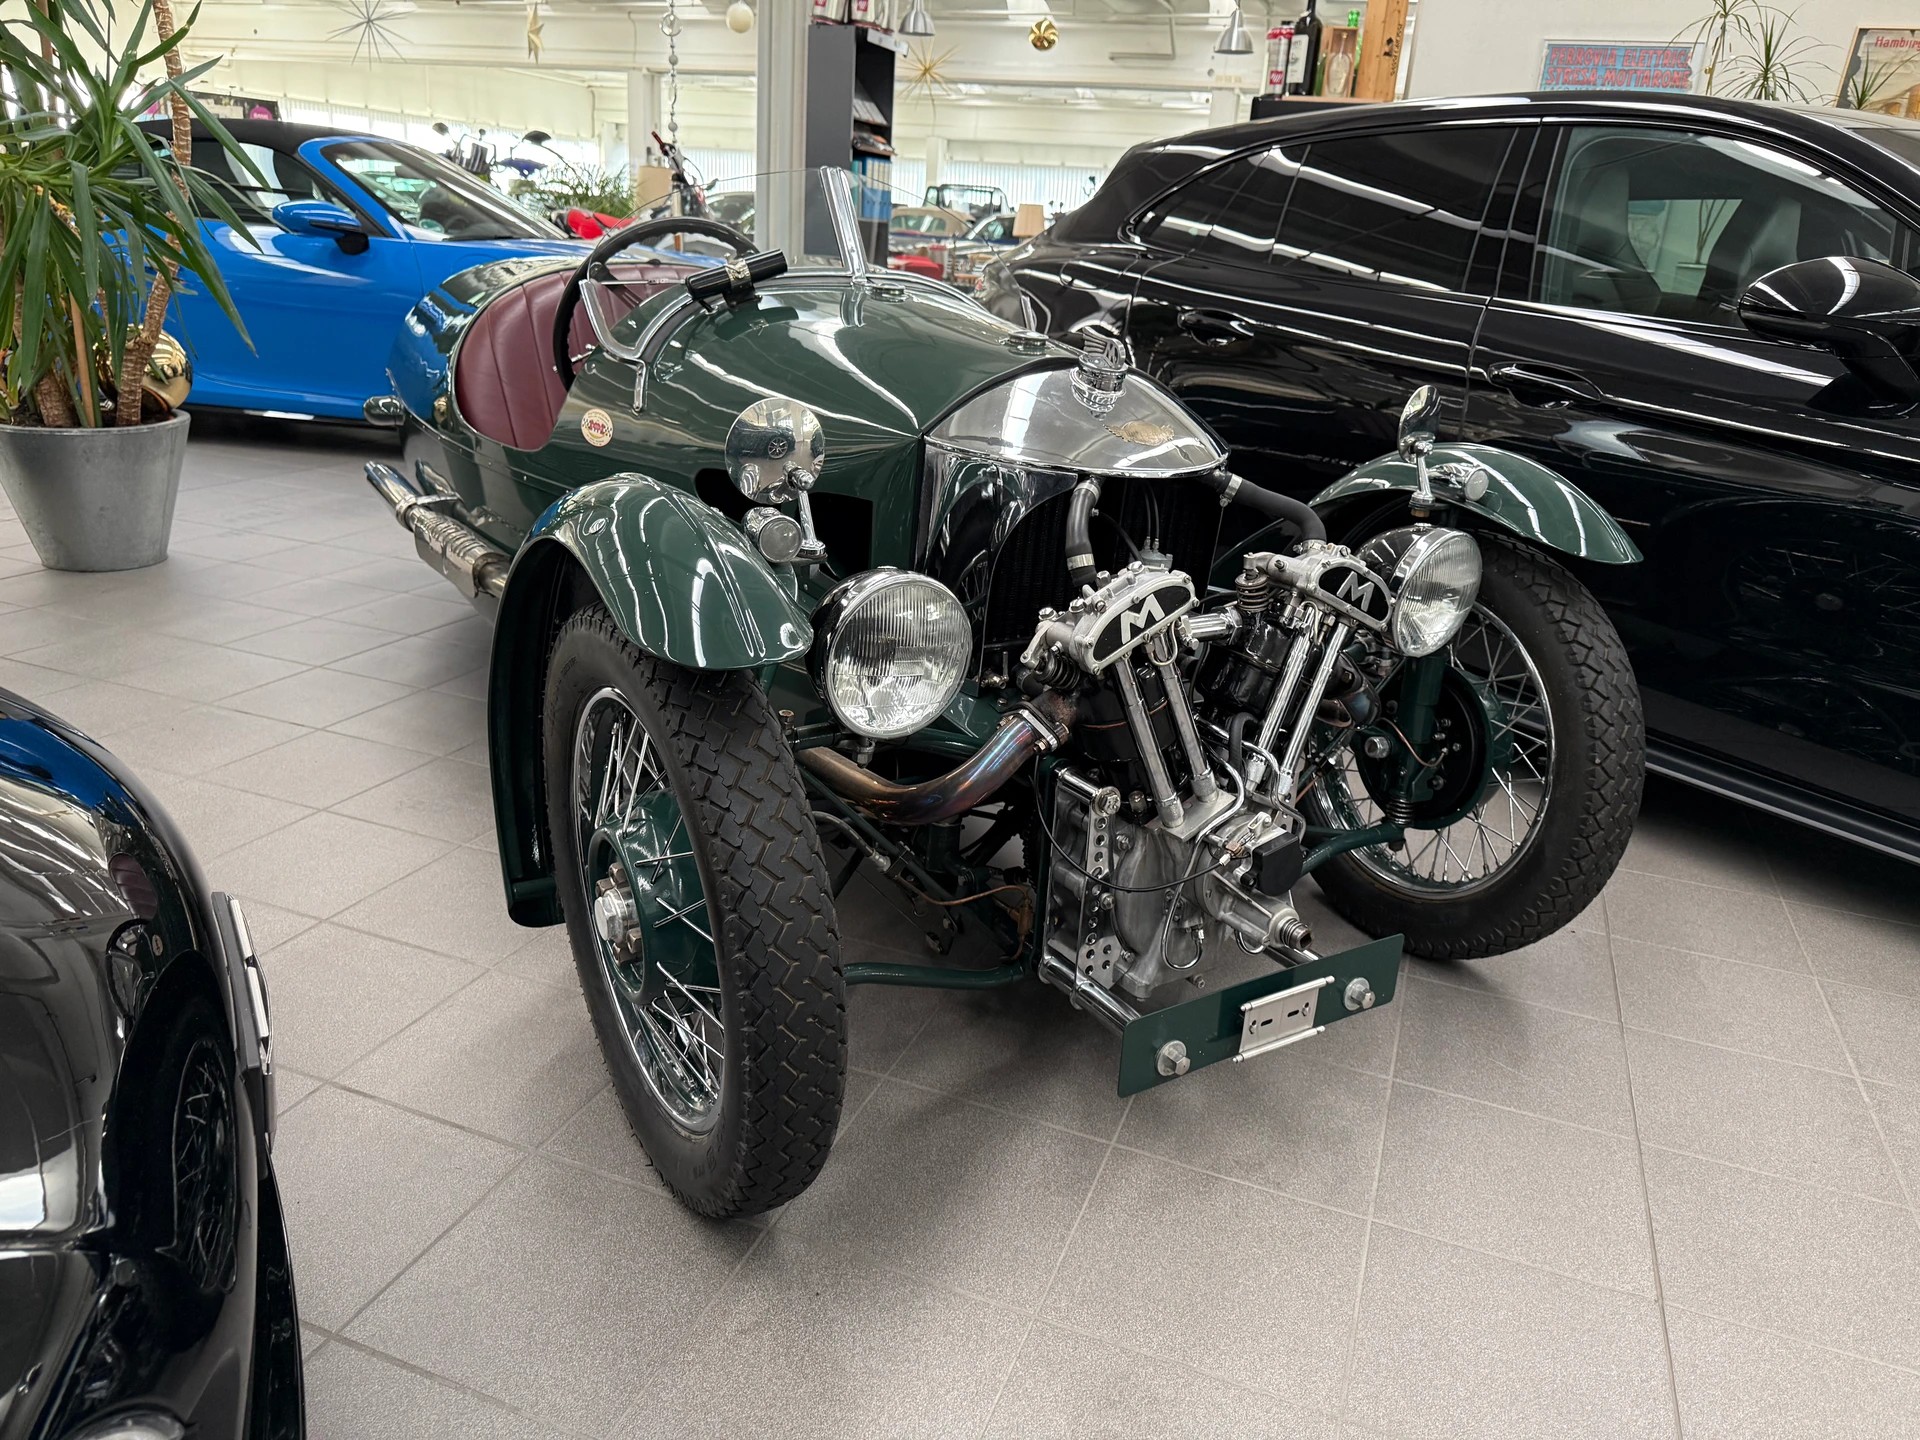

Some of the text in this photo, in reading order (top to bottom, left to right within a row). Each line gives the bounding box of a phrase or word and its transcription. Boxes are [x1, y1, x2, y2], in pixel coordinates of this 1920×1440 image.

[1550, 46, 1617, 66] FERROVIA
[1336, 571, 1375, 612] M
[1120, 593, 1166, 645] M
